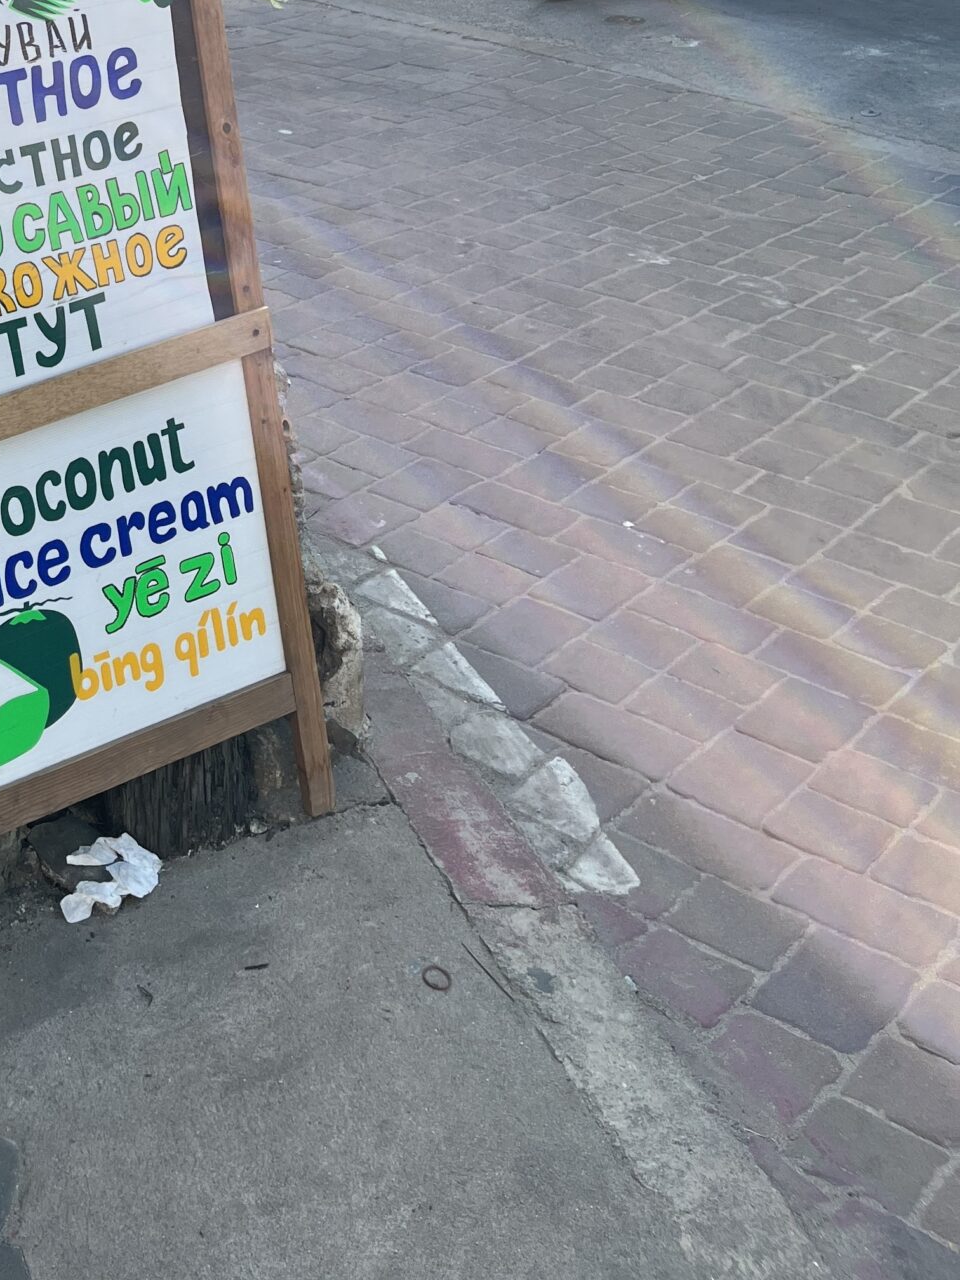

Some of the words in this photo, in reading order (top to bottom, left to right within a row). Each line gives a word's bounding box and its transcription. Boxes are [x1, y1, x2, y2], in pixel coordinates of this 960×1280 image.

[79, 476, 254, 569] cream
[101, 554, 170, 635] yē
[179, 531, 238, 604] zi
[69, 642, 165, 702] bīng
